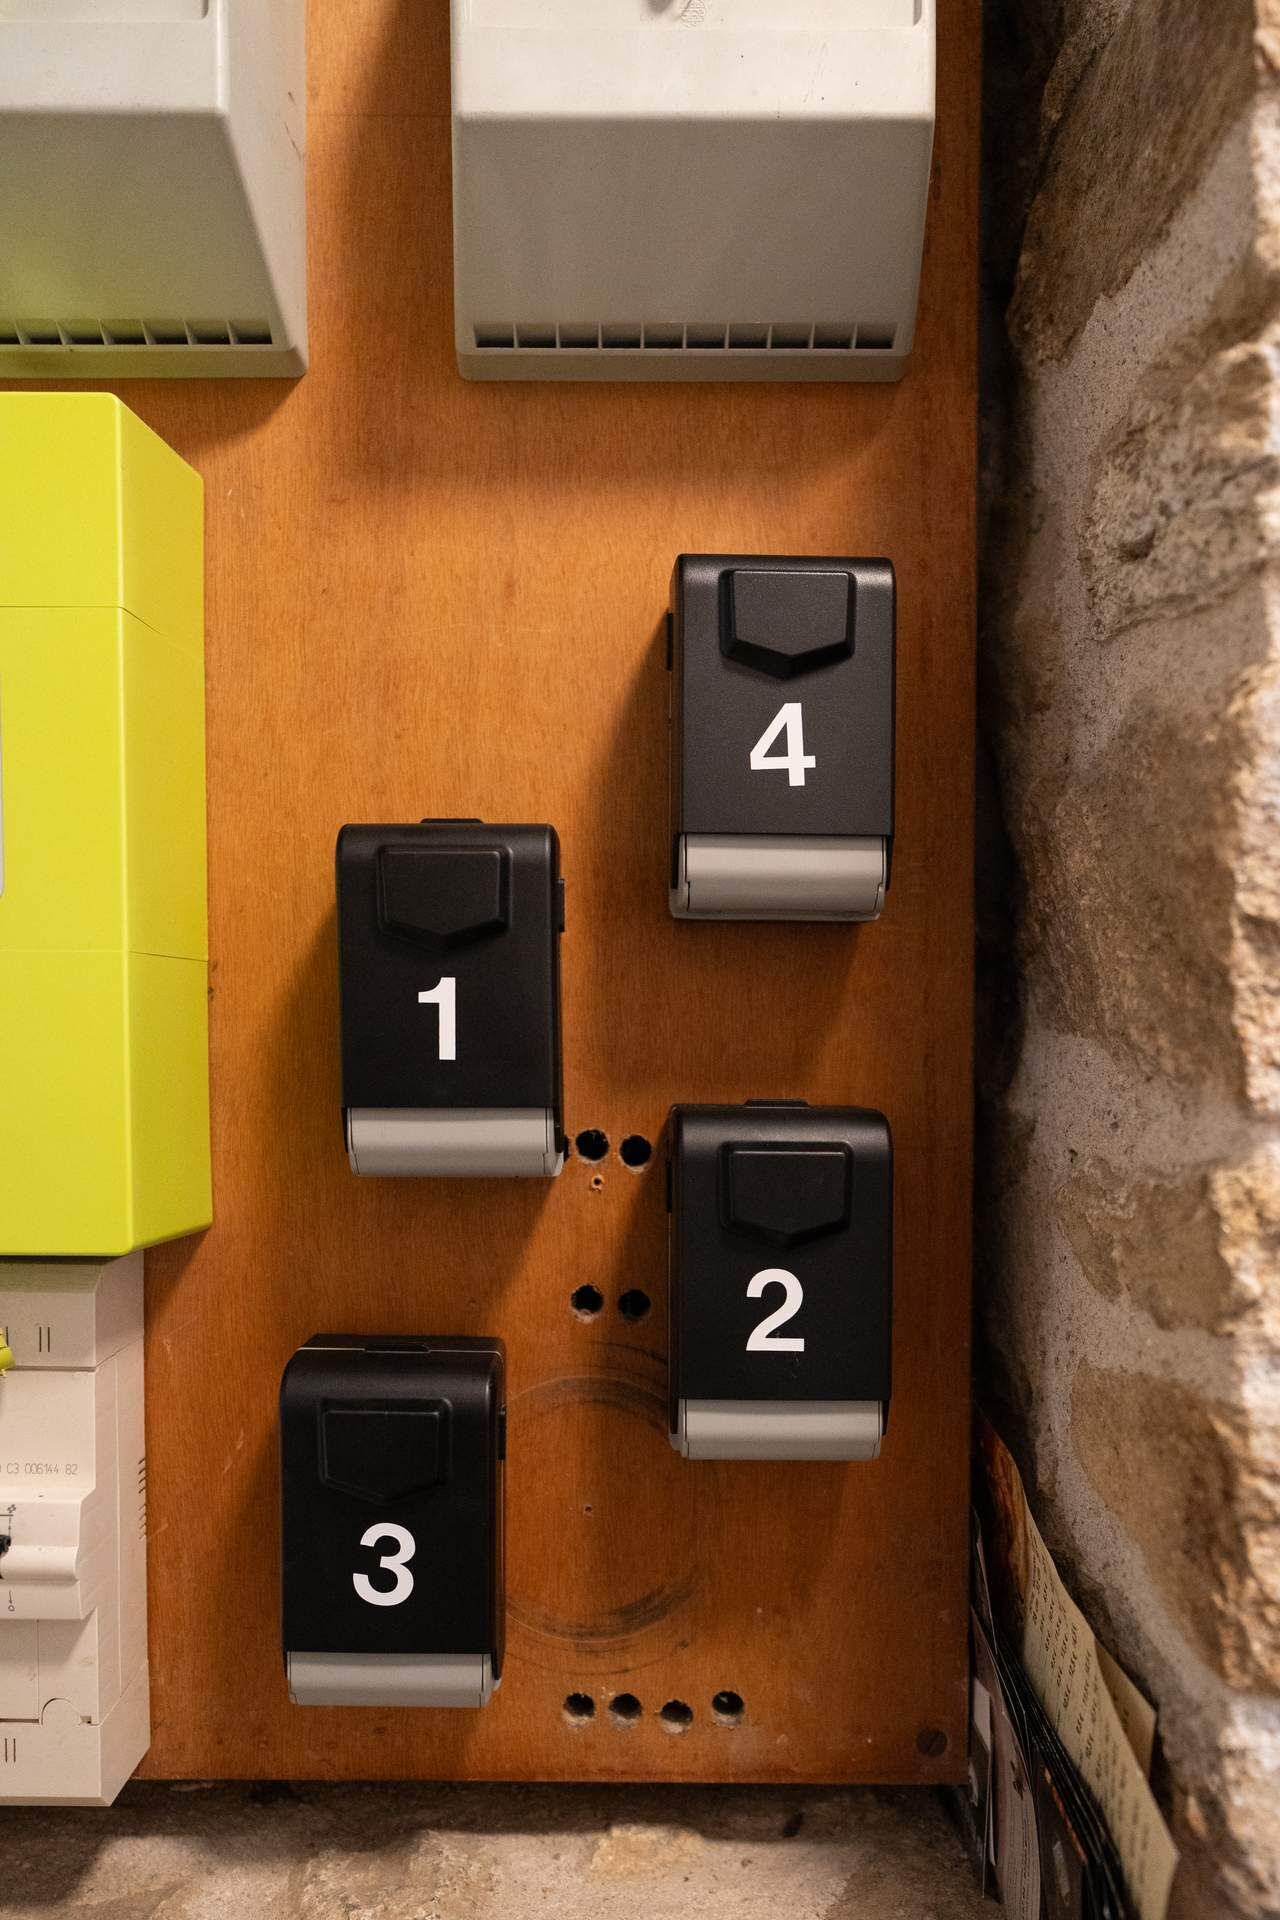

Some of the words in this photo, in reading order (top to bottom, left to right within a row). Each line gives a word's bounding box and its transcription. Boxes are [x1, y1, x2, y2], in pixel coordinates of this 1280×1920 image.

[749, 702, 817, 787] 4
[418, 976, 456, 1061] 1
[745, 1268, 805, 1352] 2
[6, 1462, 20, 1475] C3
[65, 1463, 79, 1475] 82
[352, 1522, 416, 1607] 3
